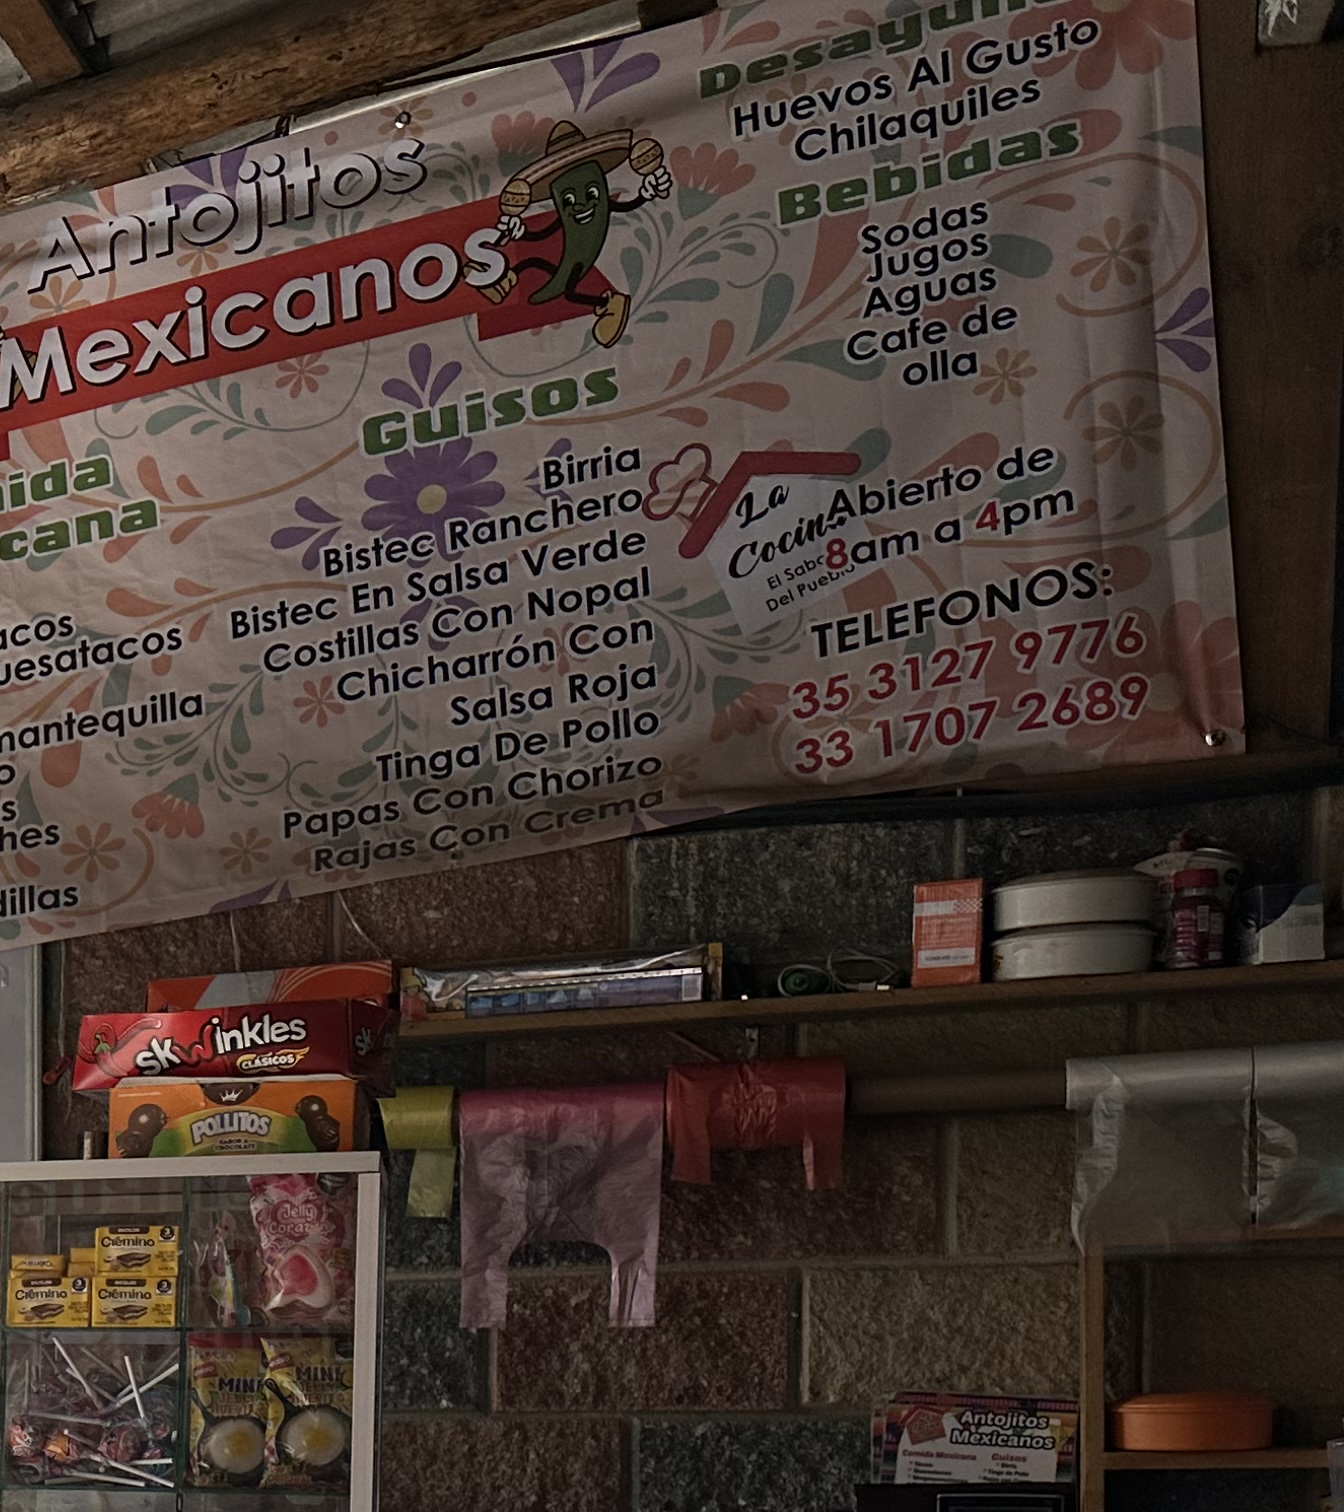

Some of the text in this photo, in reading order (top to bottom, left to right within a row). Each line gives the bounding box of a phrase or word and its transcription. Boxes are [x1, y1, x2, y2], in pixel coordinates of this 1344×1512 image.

[734, 20, 1099, 137] Huevos Al Gusto
[795, 79, 1041, 161] Chilaquiles
[777, 120, 1082, 226] Bebidas
[27, 138, 427, 293] Antojitos
[861, 201, 989, 255] Sodas
[863, 267, 997, 319] Aguas
[867, 231, 989, 283] Jugos
[846, 304, 1018, 362] Cafe de
[902, 351, 980, 387] olla
[363, 366, 619, 457] Guisos
[543, 445, 642, 490] Birria
[735, 484, 790, 529] La
[827, 446, 1054, 522] Abierto de
[323, 489, 643, 578] Bistec Ranchero
[825, 488, 1075, 570] 8am a 4pm
[230, 530, 647, 639] Bistec En Salsa Verde
[263, 566, 652, 673] Costillas Con Nopal
[765, 589, 795, 612] Del
[766, 574, 782, 590] El
[812, 561, 1114, 658] TELEFONOS:
[337, 619, 654, 701] Chicharrón Con
[451, 663, 657, 726] Salsa Roja
[792, 614, 1146, 720] 35 3127 9776
[376, 706, 659, 784] Tinga De Pollo
[795, 674, 1150, 776] 33 1707 2689
[283, 755, 663, 840] Papas Con Chorizo
[314, 788, 664, 872] Rajas Con Crema
[190, 1111, 273, 1146] POLLITOS
[283, 1204, 315, 1221] Jelly
[951, 1430, 1055, 1449] Mexicanos
[962, 1410, 1049, 1429] Antojitos
